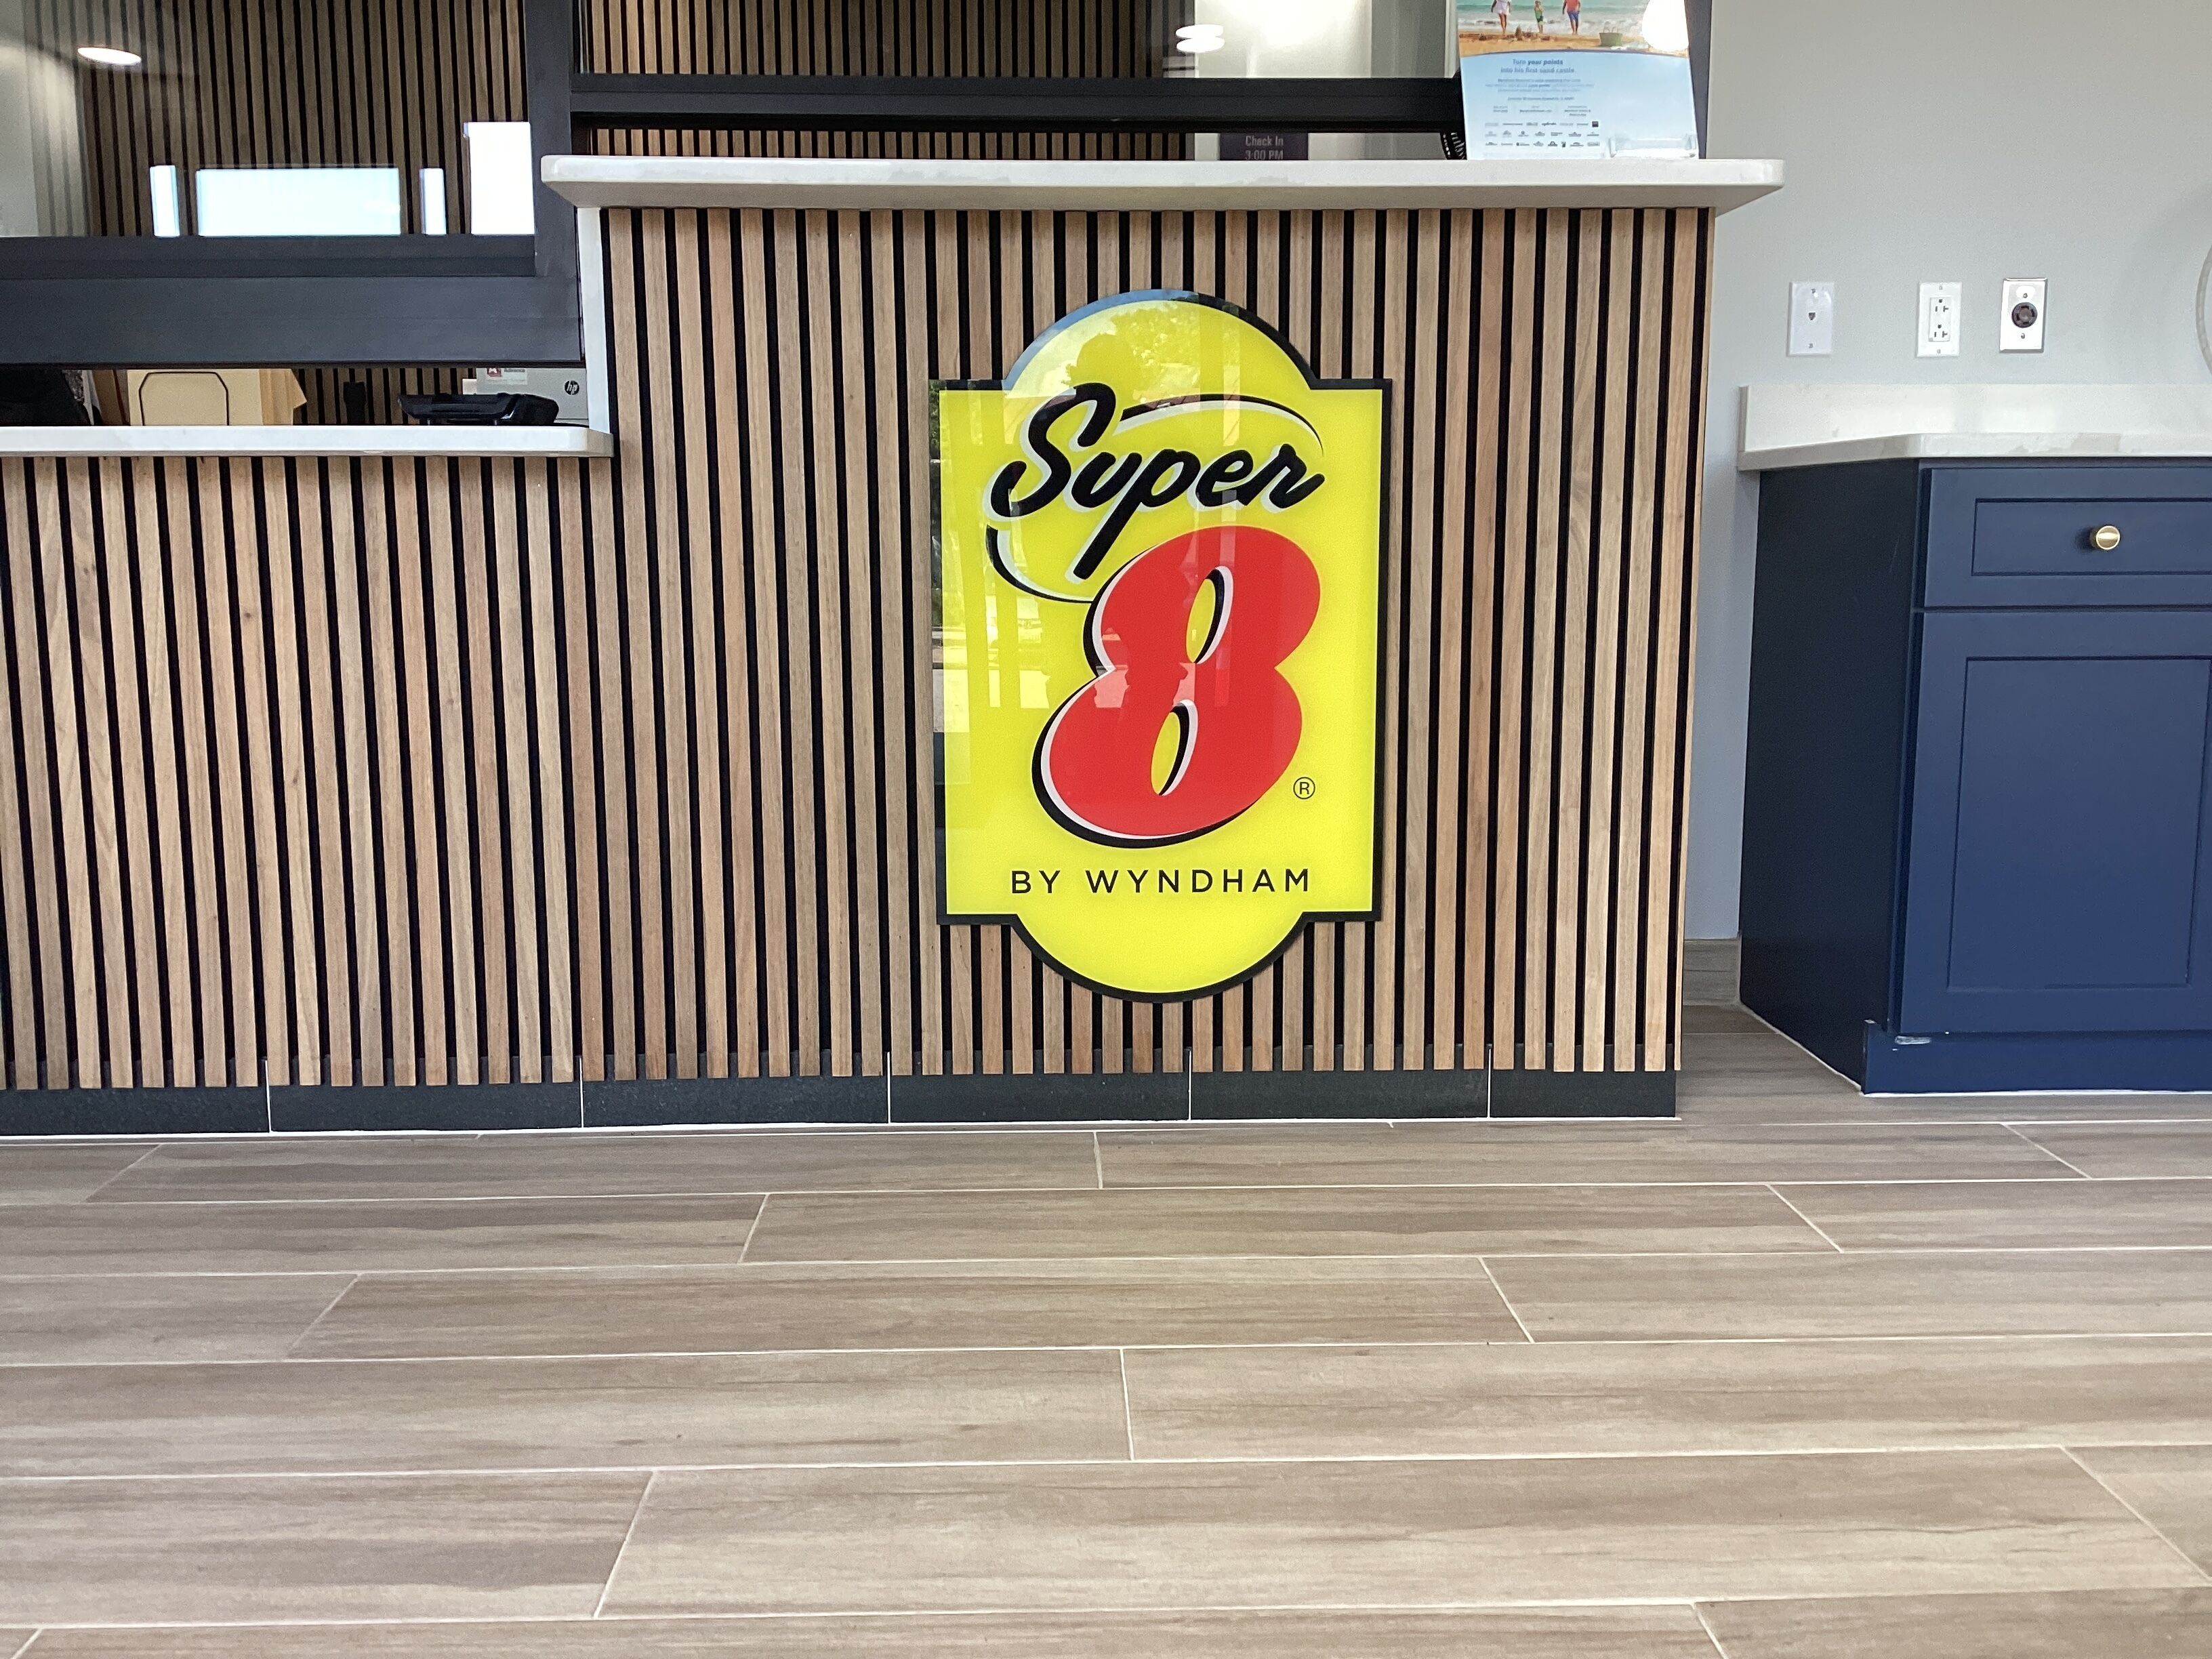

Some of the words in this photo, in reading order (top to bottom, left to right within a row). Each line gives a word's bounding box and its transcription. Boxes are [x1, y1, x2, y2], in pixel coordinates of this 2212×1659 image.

[1245, 135, 1272, 146] Check
[1275, 135, 1284, 146] In
[1245, 149, 1266, 160] 3:00
[1269, 149, 1284, 160] PM
[565, 380, 579, 395] hp
[989, 383, 1324, 579] Super
[1032, 525, 1321, 849] 8
[1011, 870, 1061, 894] BY
[1085, 868, 1309, 893] WYNDHAM
